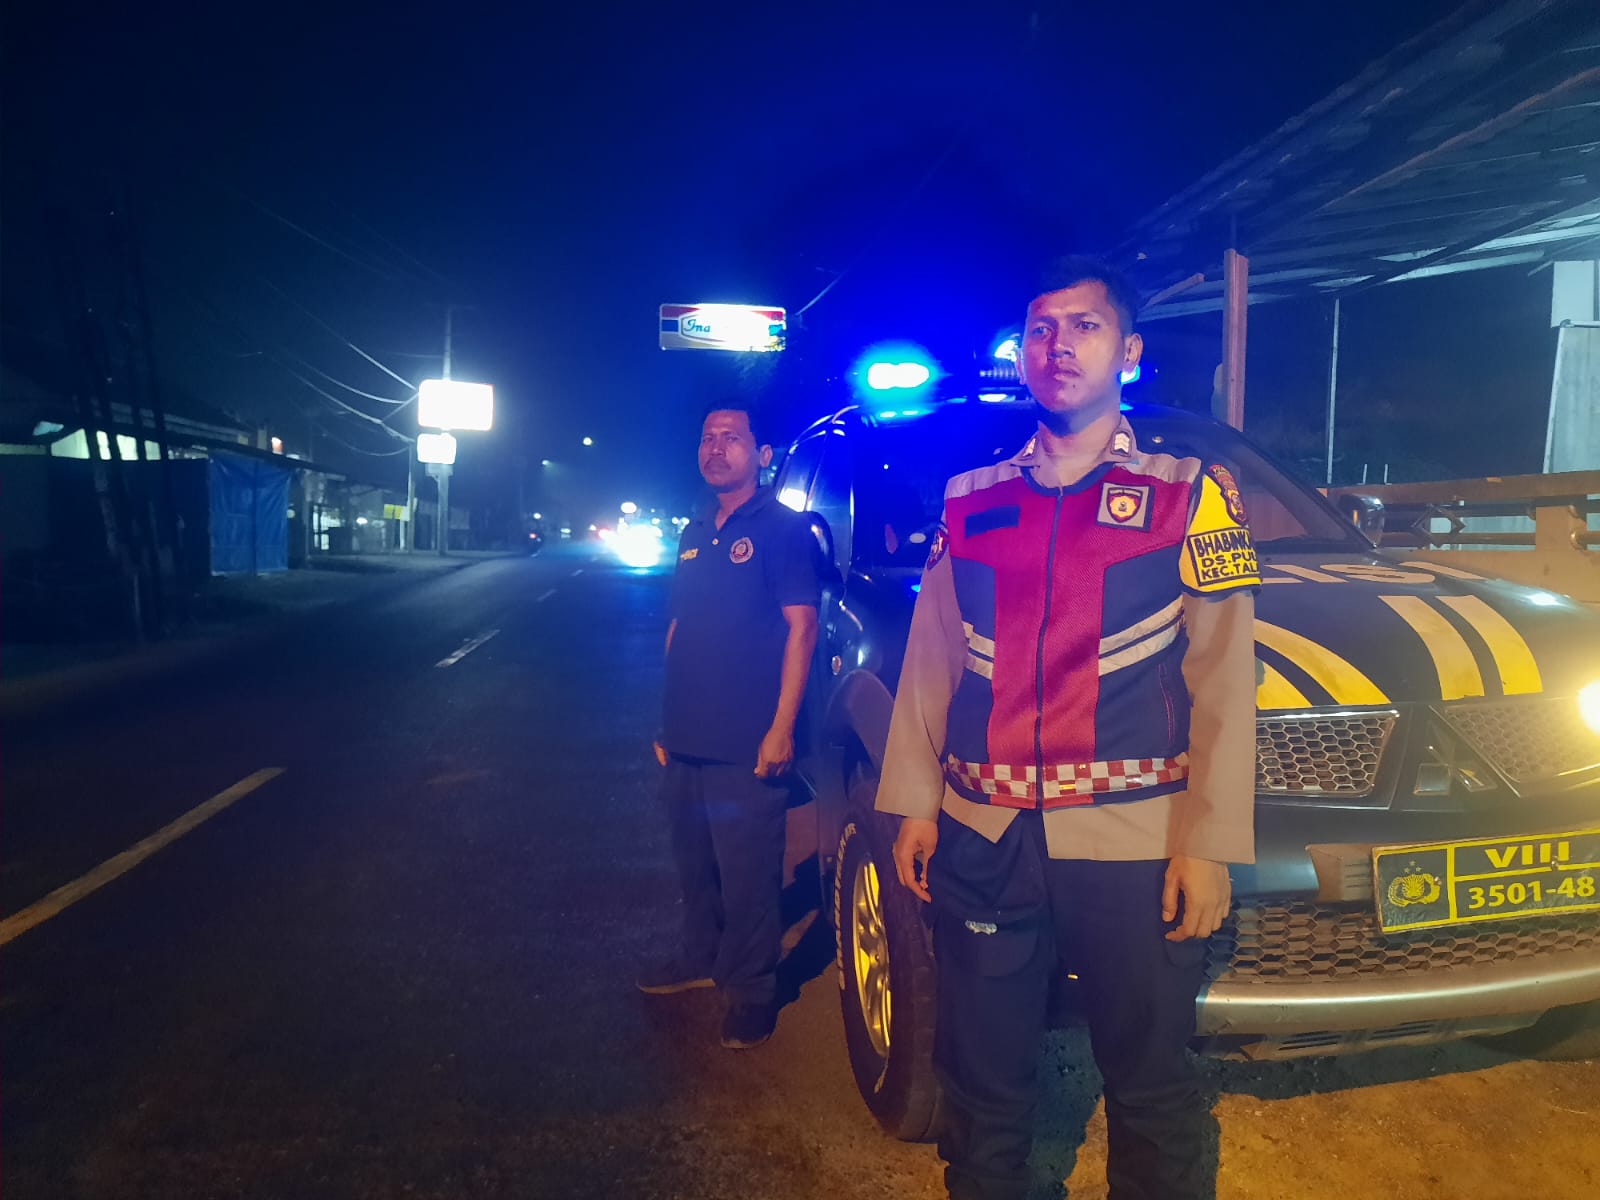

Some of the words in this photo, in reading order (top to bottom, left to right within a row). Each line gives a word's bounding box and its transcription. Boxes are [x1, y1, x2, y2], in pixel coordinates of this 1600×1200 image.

[1194, 530, 1253, 557] BHABINK
[1485, 841, 1570, 868] VIII
[1468, 876, 1596, 909] 3501-48
